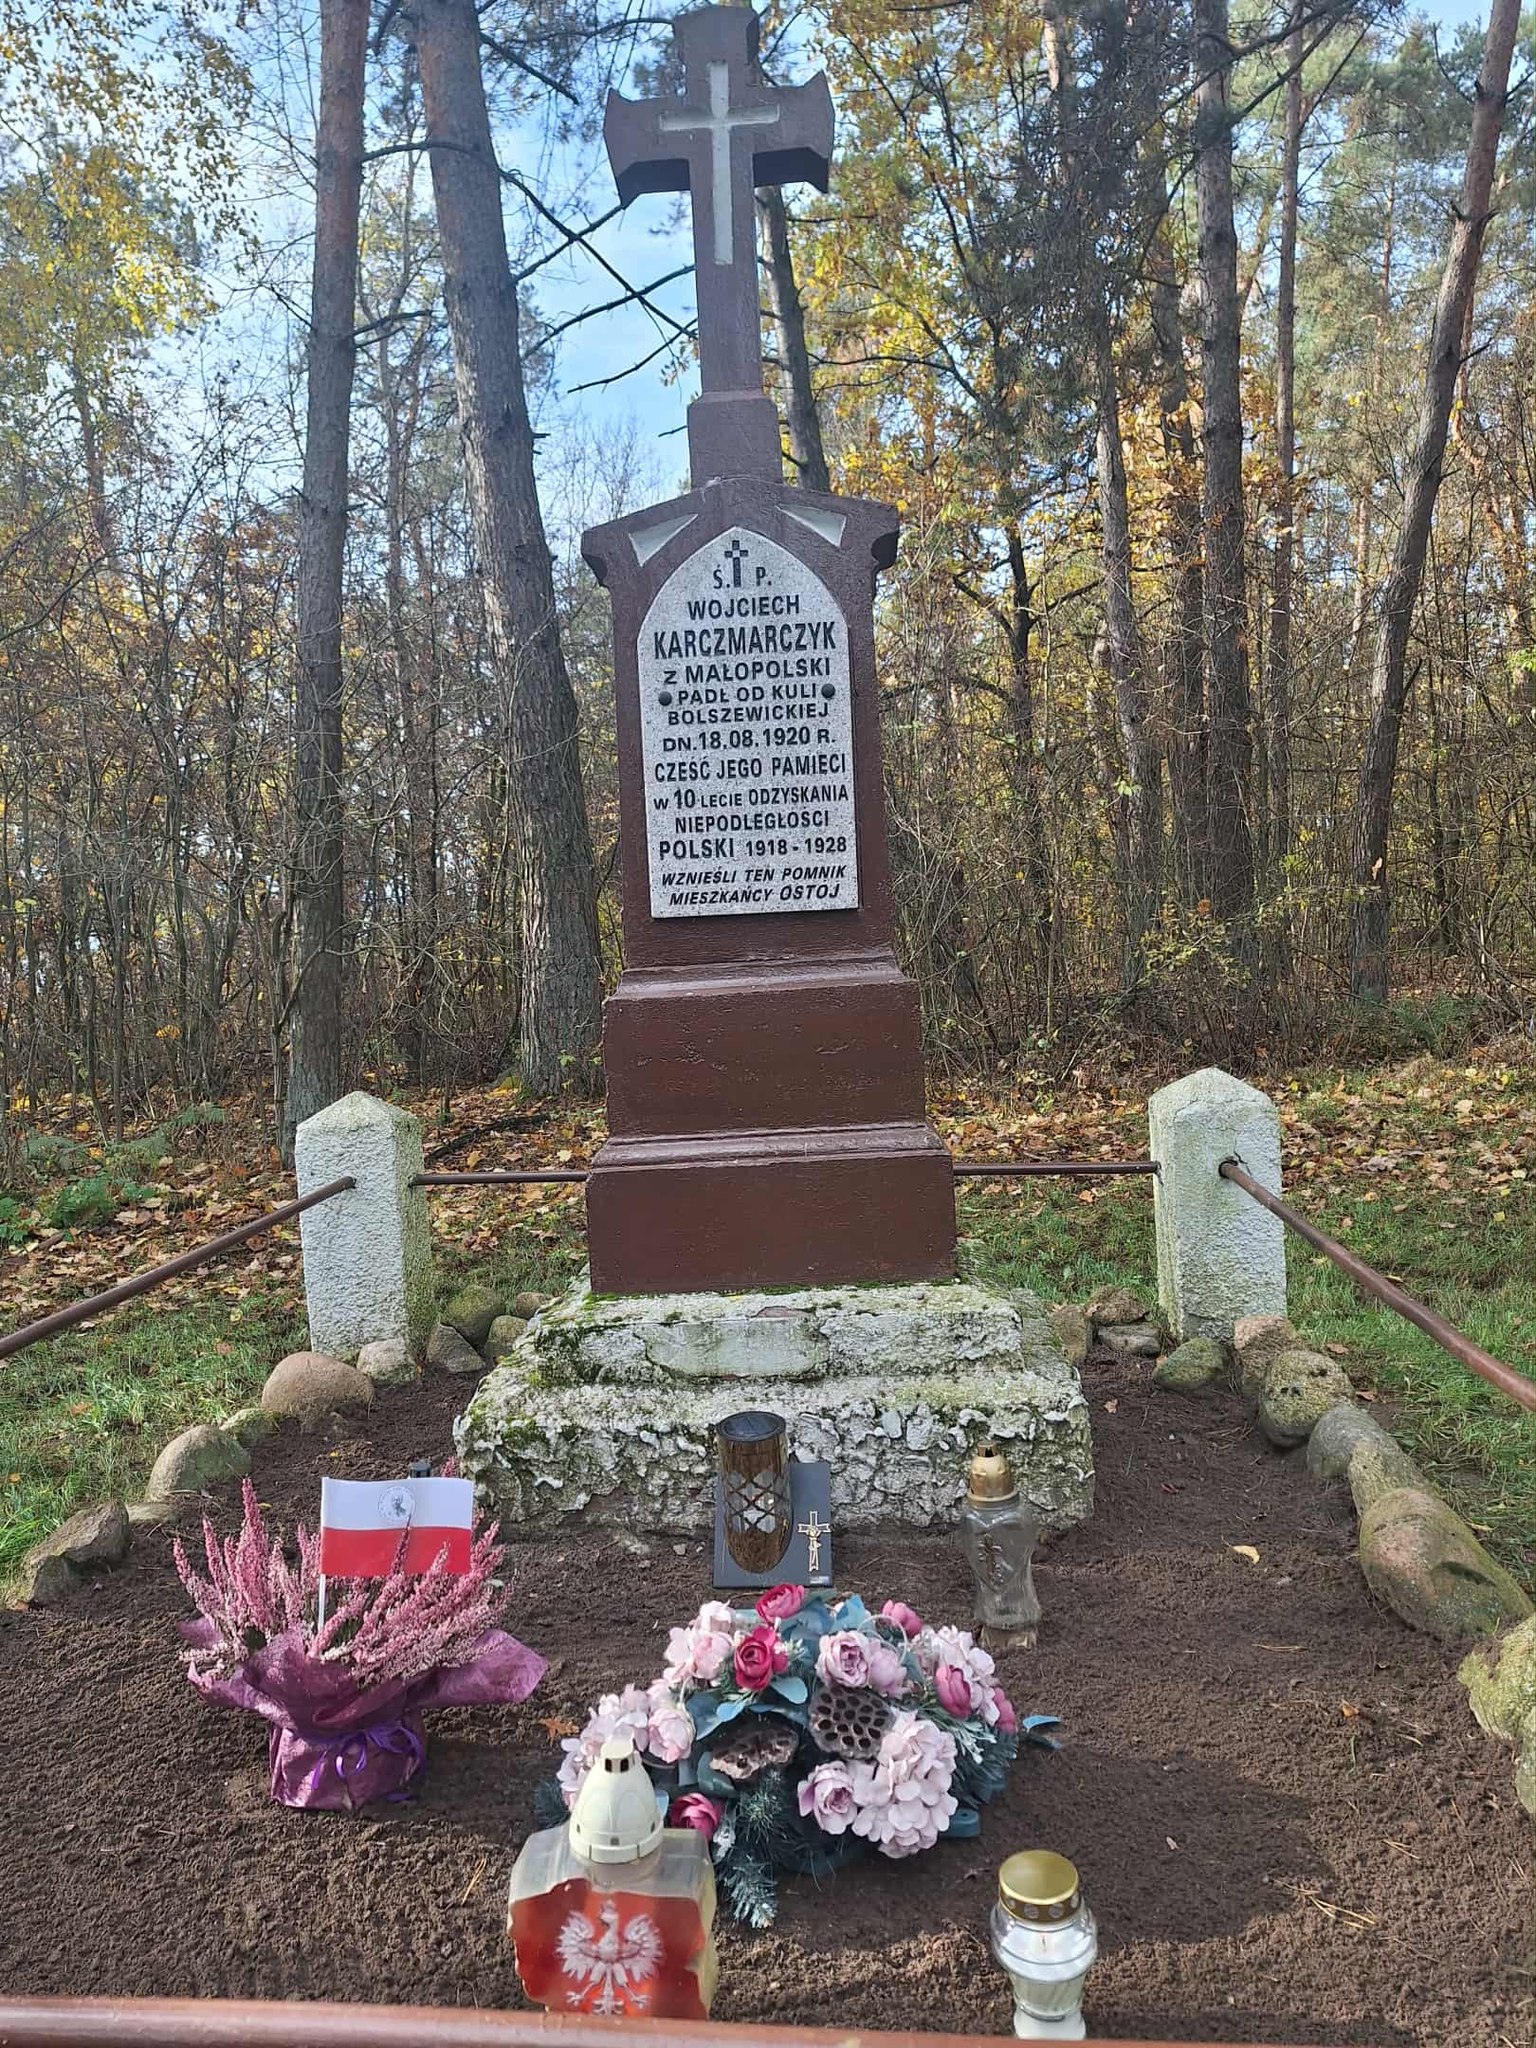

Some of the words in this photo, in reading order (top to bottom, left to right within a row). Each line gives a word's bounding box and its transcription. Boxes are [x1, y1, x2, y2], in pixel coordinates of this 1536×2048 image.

[756, 567, 771, 586] P.
[688, 595, 799, 620] WOJCIECH
[654, 622, 836, 659] KARCZMARCZYK
[686, 658, 830, 684] MAŁOPOLSKI
[678, 688, 729, 705] PADŁ
[737, 687, 764, 702] OD
[773, 683, 816, 699] KULI
[668, 703, 828, 725] BOLSZEWICKIEJ
[655, 756, 710, 782] CZEŚĆ
[717, 758, 762, 779] JEGO
[773, 754, 845, 776] PAMIĘCI
[749, 785, 848, 805] ODZYSKANIA
[660, 838, 734, 860] POLSKI
[746, 841, 787, 856] 1918
[807, 837, 847, 854] 1928
[662, 866, 737, 886] WZNIEŚLI
[745, 869, 774, 882] TEN
[782, 865, 847, 880] POMNIK
[669, 887, 772, 905] MIESZKAŃCY
